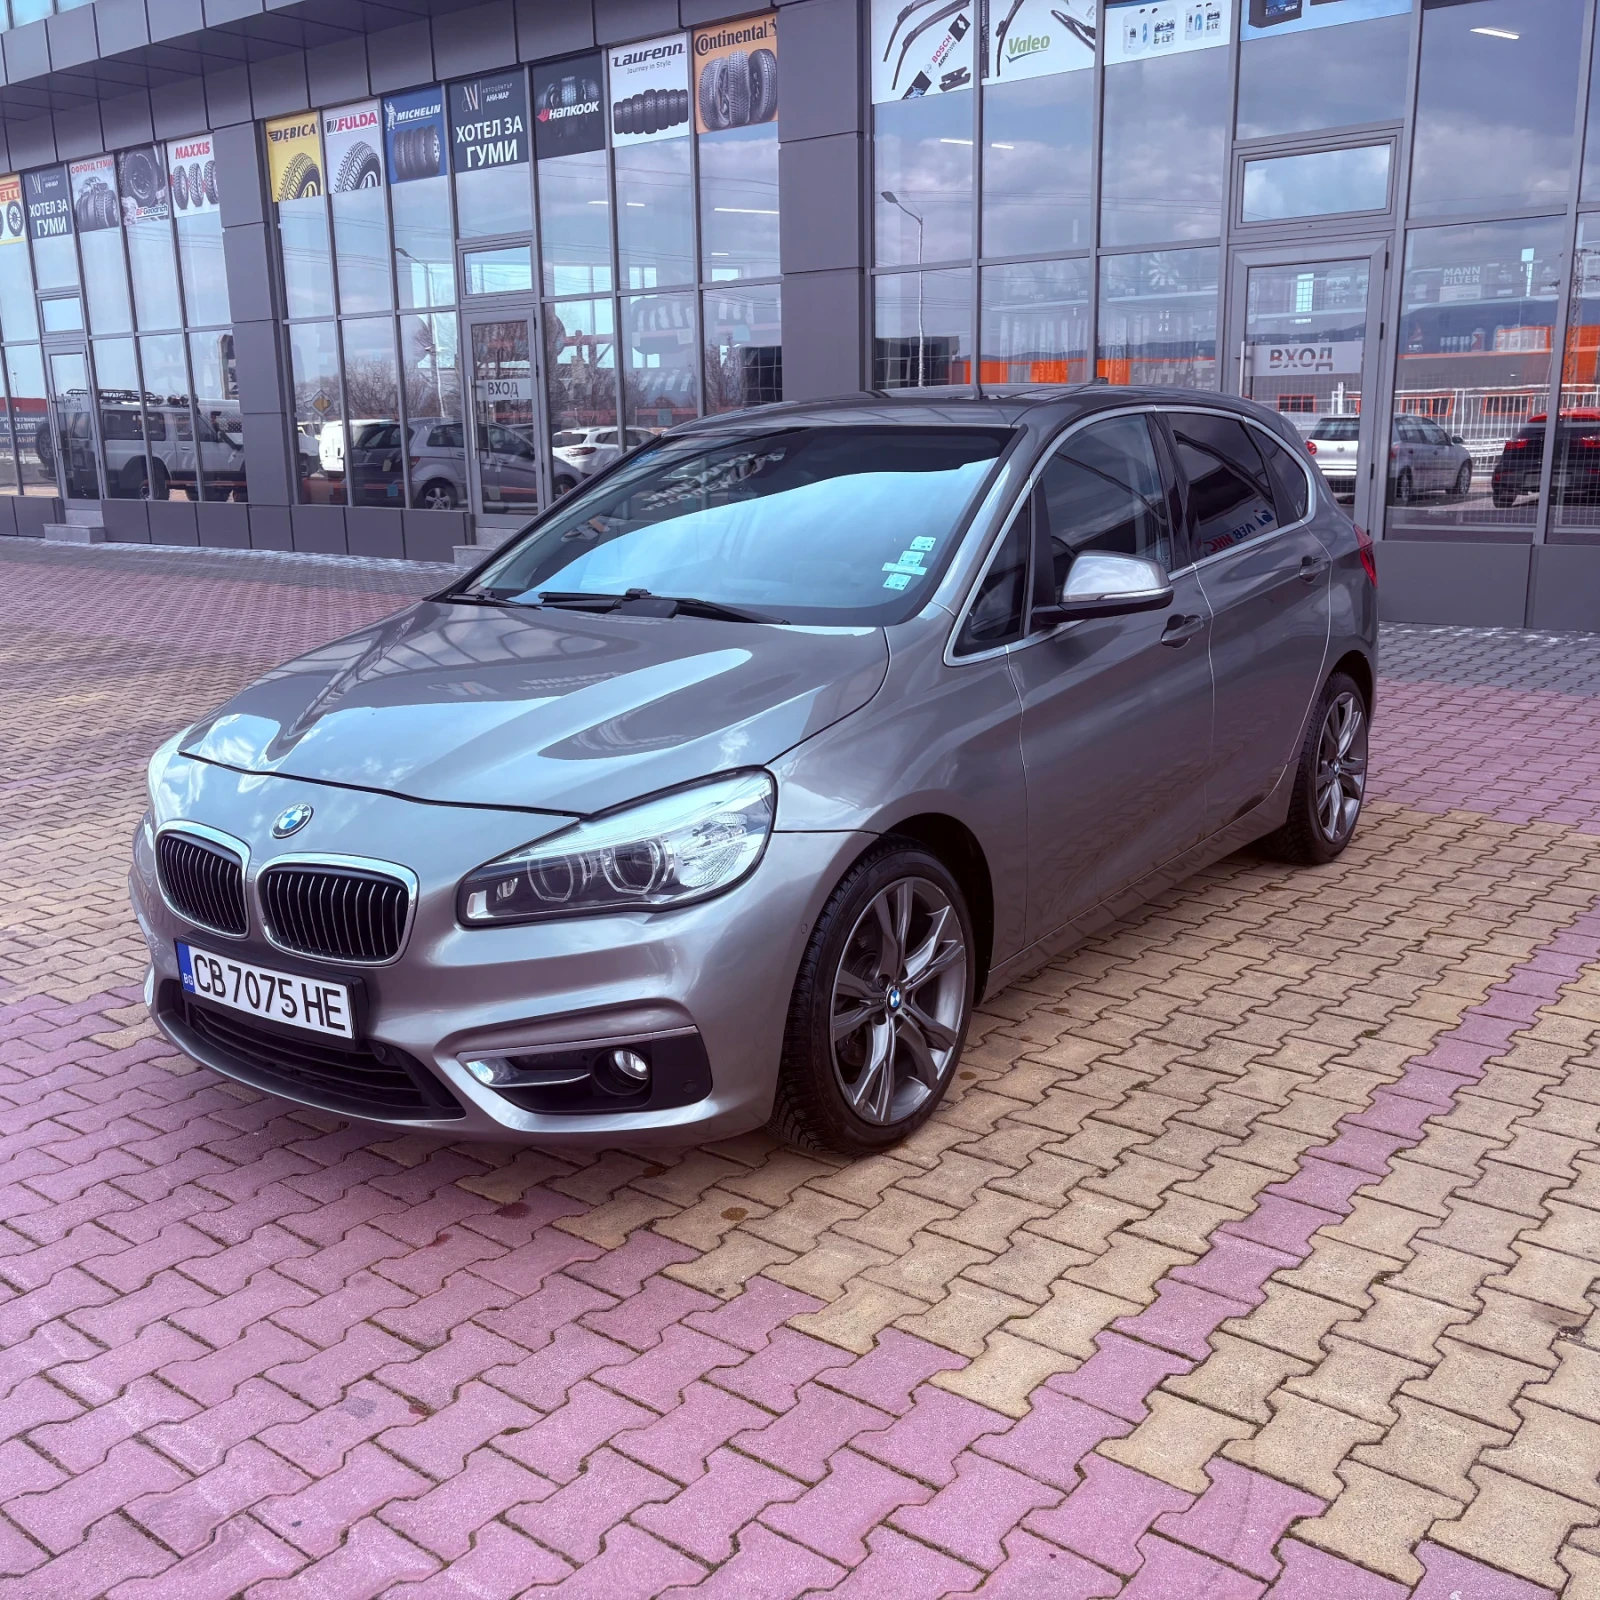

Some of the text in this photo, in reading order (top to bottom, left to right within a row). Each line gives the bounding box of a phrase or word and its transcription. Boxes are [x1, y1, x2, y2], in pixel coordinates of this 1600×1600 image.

[695, 20, 768, 56] Continental
[1008, 34, 1051, 55] Valeo
[931, 34, 953, 63] BOSCH
[626, 64, 648, 75] Journey
[656, 60, 671, 69] Style
[486, 91, 510, 102] АНИ-МАР
[337, 111, 378, 132] FULDA
[396, 104, 441, 121] MICHELIN
[455, 115, 523, 144] ХОТЕЛ ЗА
[175, 141, 211, 160] MAXXIS
[466, 139, 518, 168] ГУМИ
[96, 158, 114, 170] ГУМИ
[29, 198, 68, 217] ХОТЕЛ ЗА
[36, 216, 67, 237] ГУМИ
[1443, 266, 1481, 276] MANN
[1443, 275, 1480, 285] FILTER
[1269, 346, 1333, 372] ВХОД
[487, 380, 519, 398] ВХОД
[183, 973, 194, 986] BG
